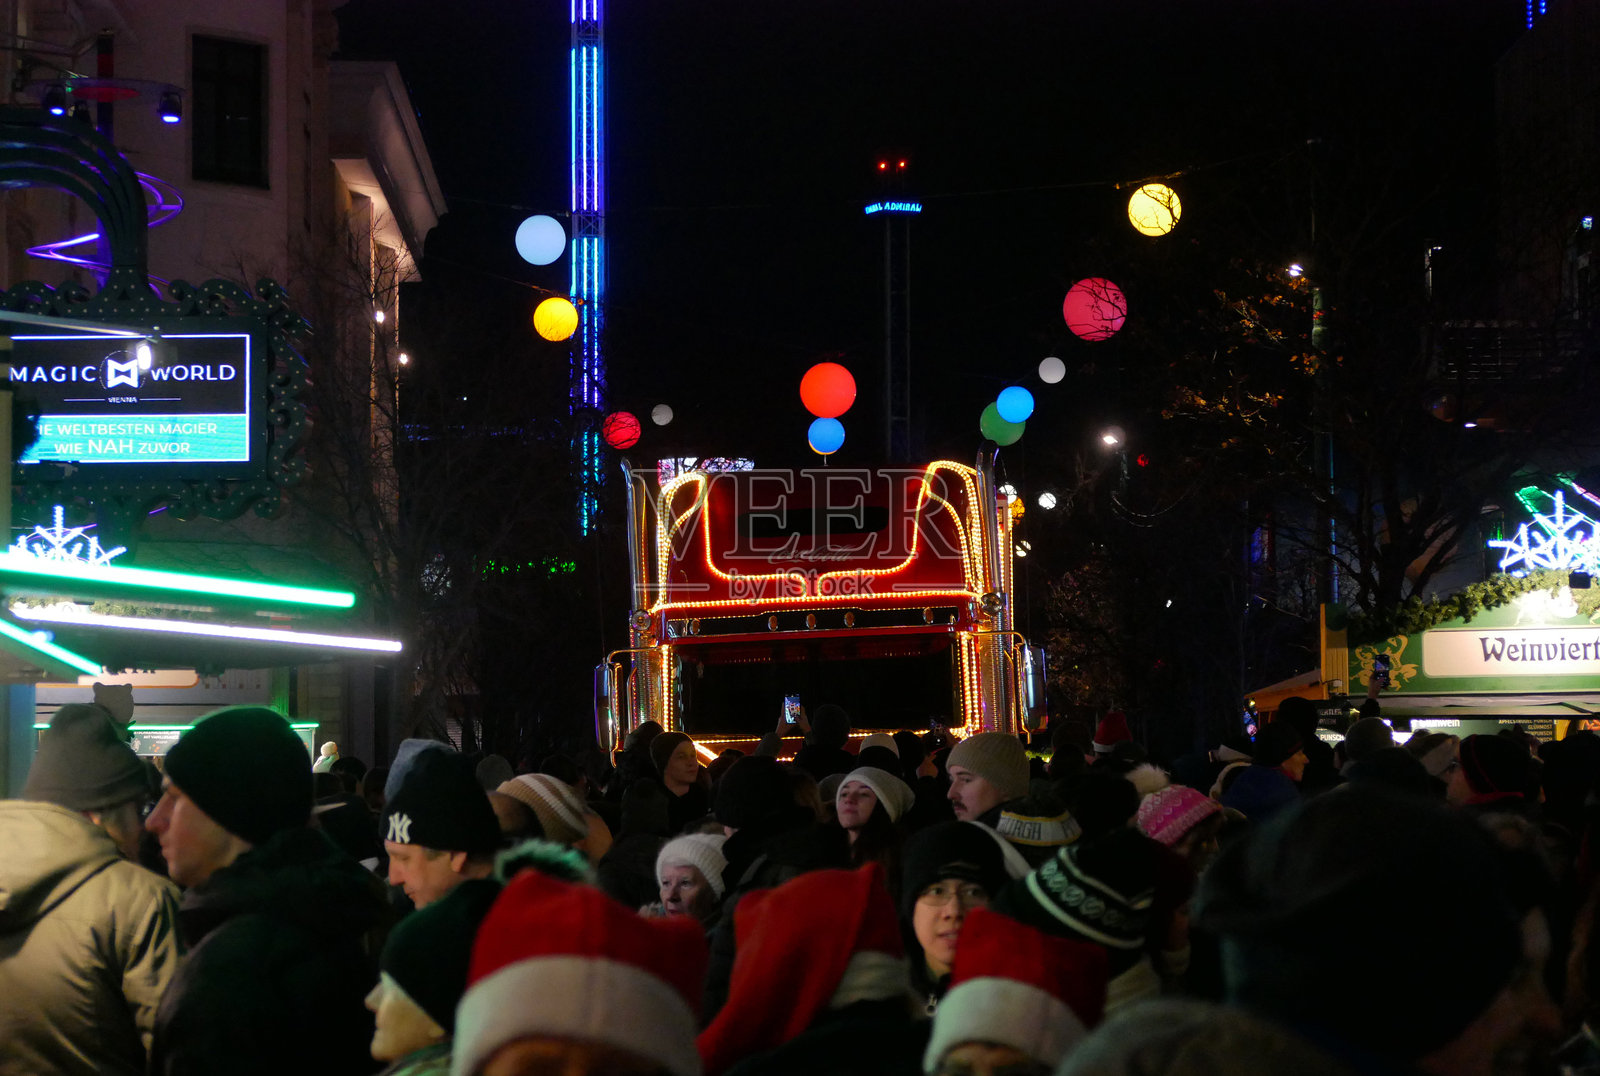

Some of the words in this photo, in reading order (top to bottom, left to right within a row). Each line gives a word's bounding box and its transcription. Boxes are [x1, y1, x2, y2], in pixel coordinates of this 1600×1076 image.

[9, 365, 97, 382] MAGIC
[151, 364, 237, 381] WORLD
[107, 396, 138, 404] VIENNA
[38, 424, 53, 435] IE
[57, 423, 155, 435] WELTBESTEN
[159, 422, 218, 435] MAGIER
[54, 442, 83, 454] WIE
[88, 438, 134, 454] NAH
[138, 441, 191, 454] ZUVOR
[387, 812, 412, 844] NY
